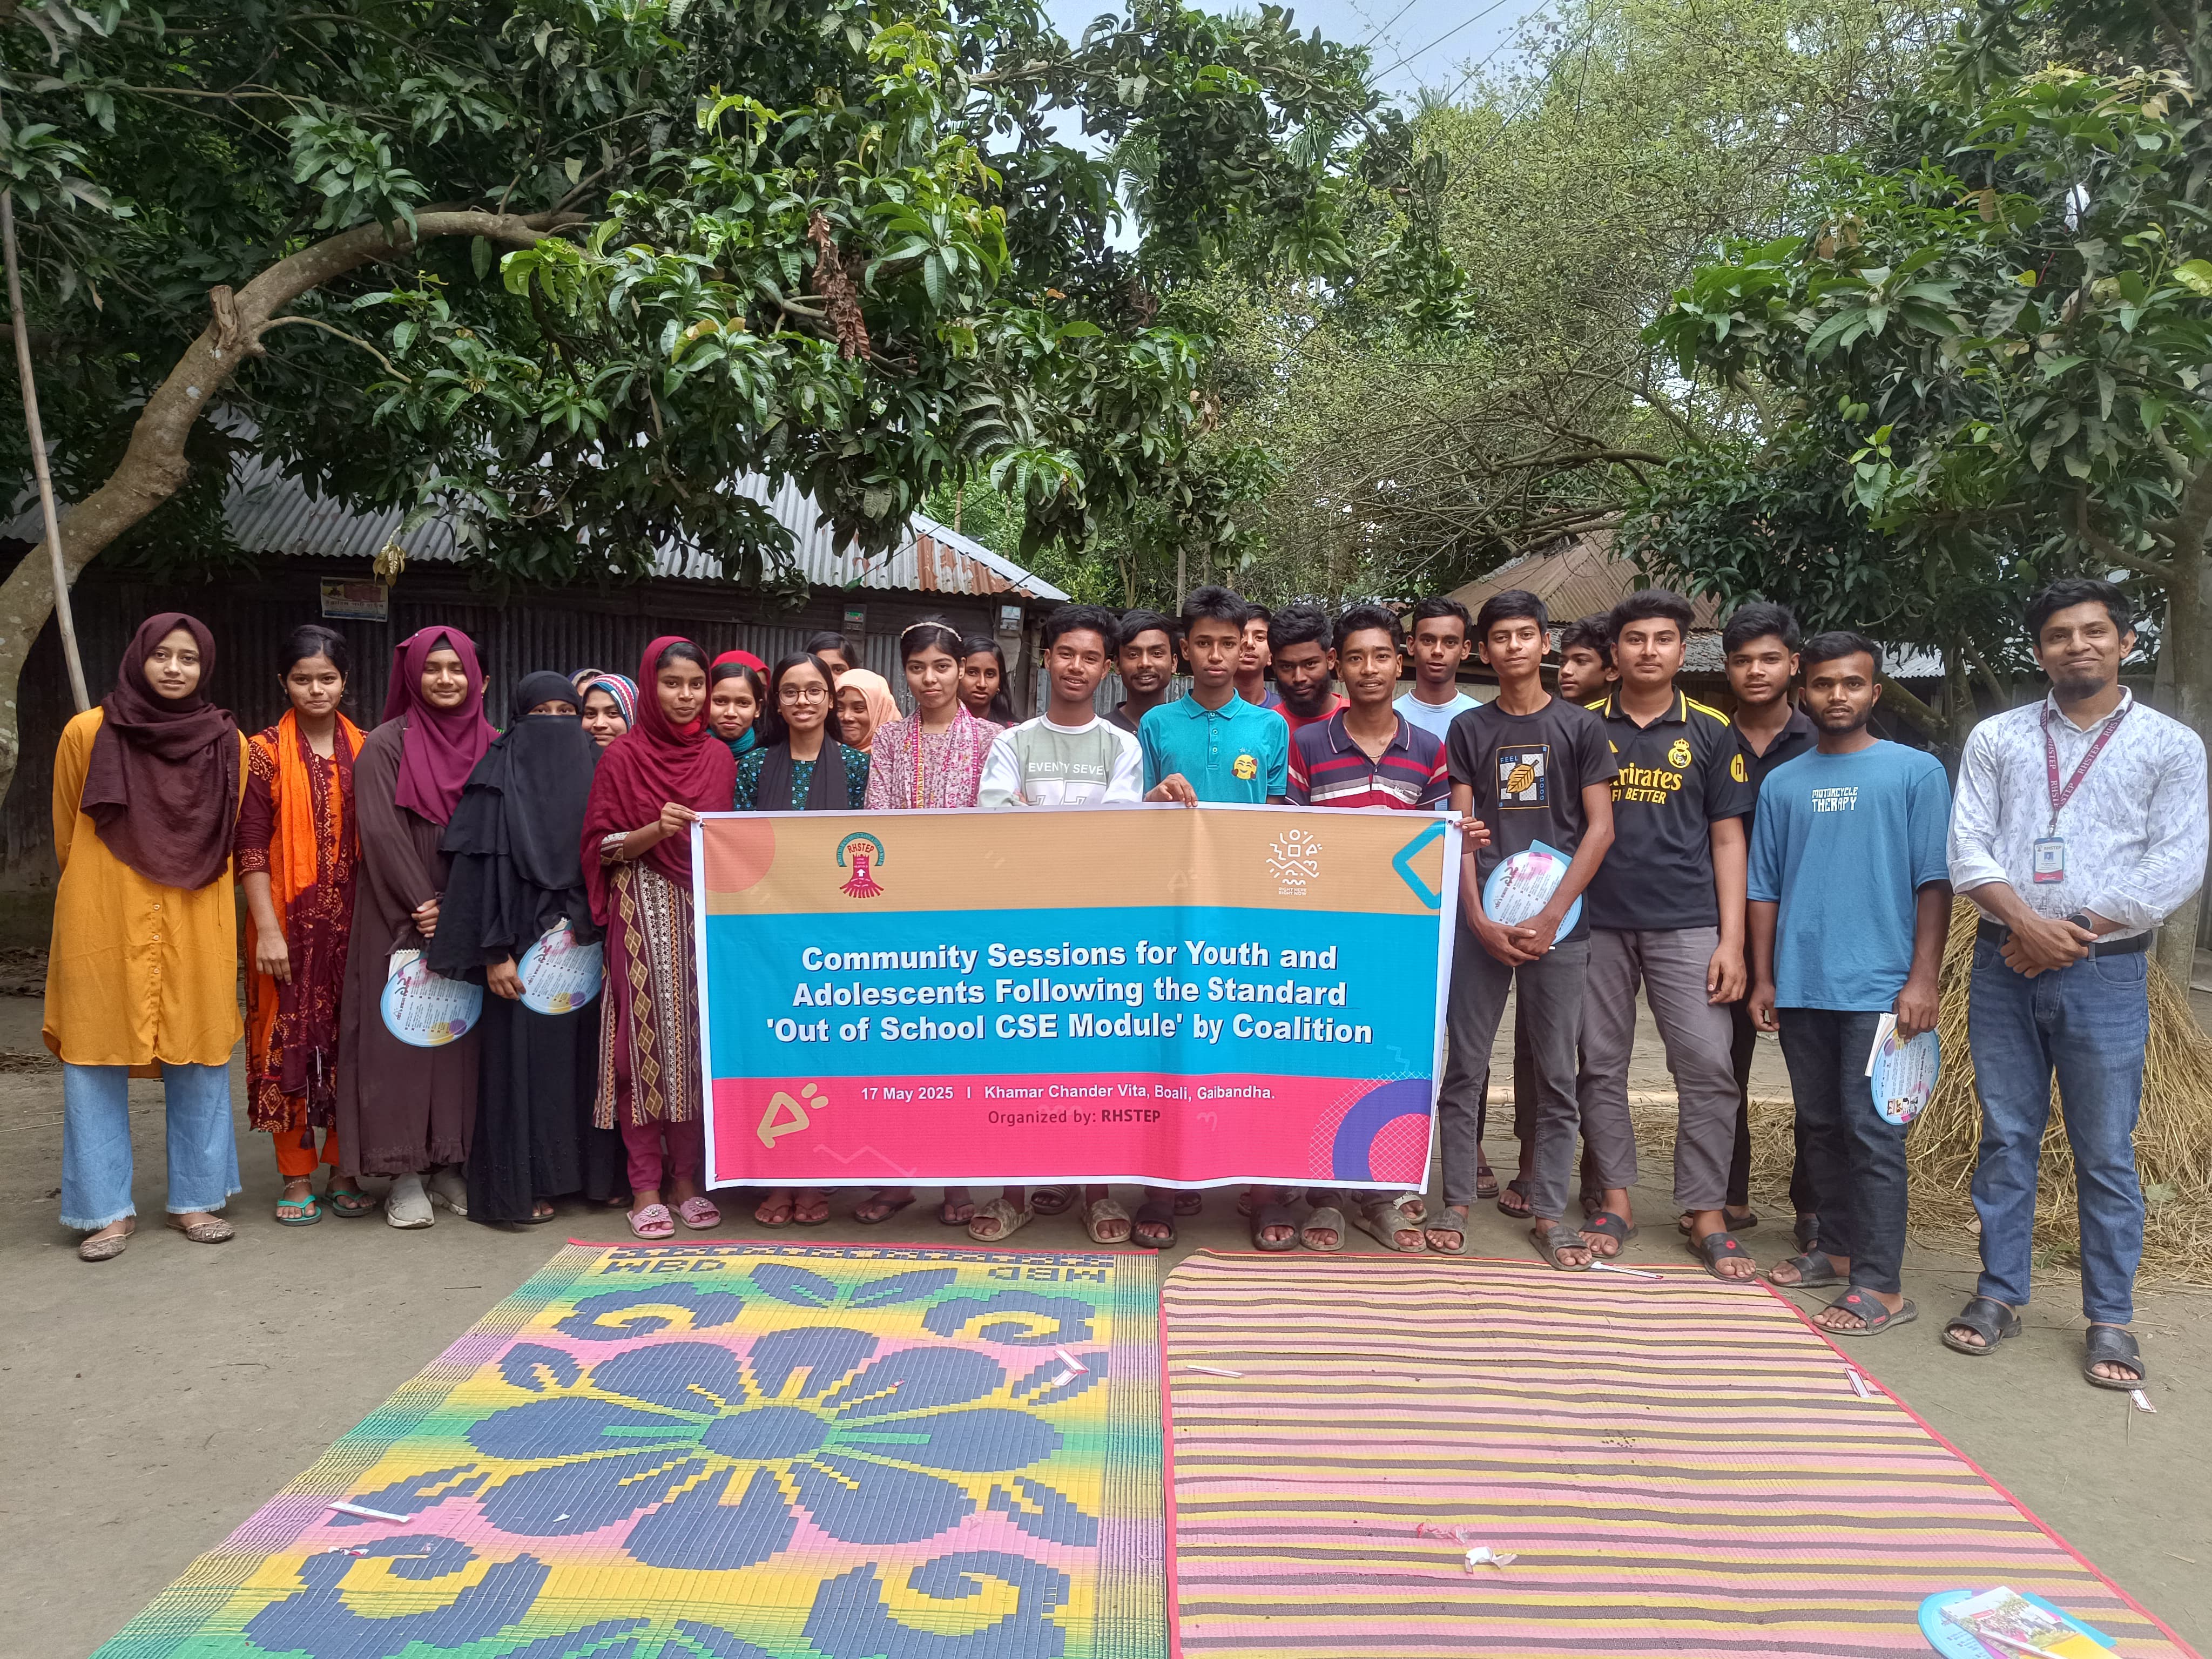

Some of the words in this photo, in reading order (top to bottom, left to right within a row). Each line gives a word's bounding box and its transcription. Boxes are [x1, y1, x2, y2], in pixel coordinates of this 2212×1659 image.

[2078, 744, 2100, 774] RHSTEP
[1625, 787, 1667, 804] BETTER
[1812, 786, 1858, 799] MOTORCYCLE
[1812, 796, 1857, 812] THERAPY
[847, 843, 874, 854] RHSTEP
[802, 945, 978, 974] Community
[988, 942, 1125, 968] Sessions
[1135, 940, 1178, 965] for
[1184, 940, 1269, 967] Youth
[1280, 946, 1337, 969] and
[792, 980, 984, 1006] Adolescents
[996, 977, 1143, 1007] Following
[1153, 976, 1199, 1002] the
[1208, 976, 1346, 1006] Standard
[767, 1018, 829, 1042] 'Out
[839, 1017, 869, 1041] of
[881, 1015, 983, 1040] School
[996, 1014, 1057, 1038] CSE
[1069, 1013, 1183, 1037] Module'
[1193, 1014, 1223, 1044] by
[1233, 1013, 1372, 1043] Coalition
[861, 1088, 878, 1100] 17
[883, 1087, 913, 1103] May
[918, 1087, 953, 1099] 2025
[984, 1086, 1044, 1098] Khamar
[1048, 1084, 1114, 1098] Chander
[1117, 1084, 1150, 1099] Vita,
[1155, 1084, 1191, 1102] Boali,
[1197, 1085, 1275, 1100] Gaibandha.
[988, 1110, 1067, 1127] Organized
[1074, 1109, 1096, 1125] by:
[1102, 1109, 1161, 1123] RHSTEP
